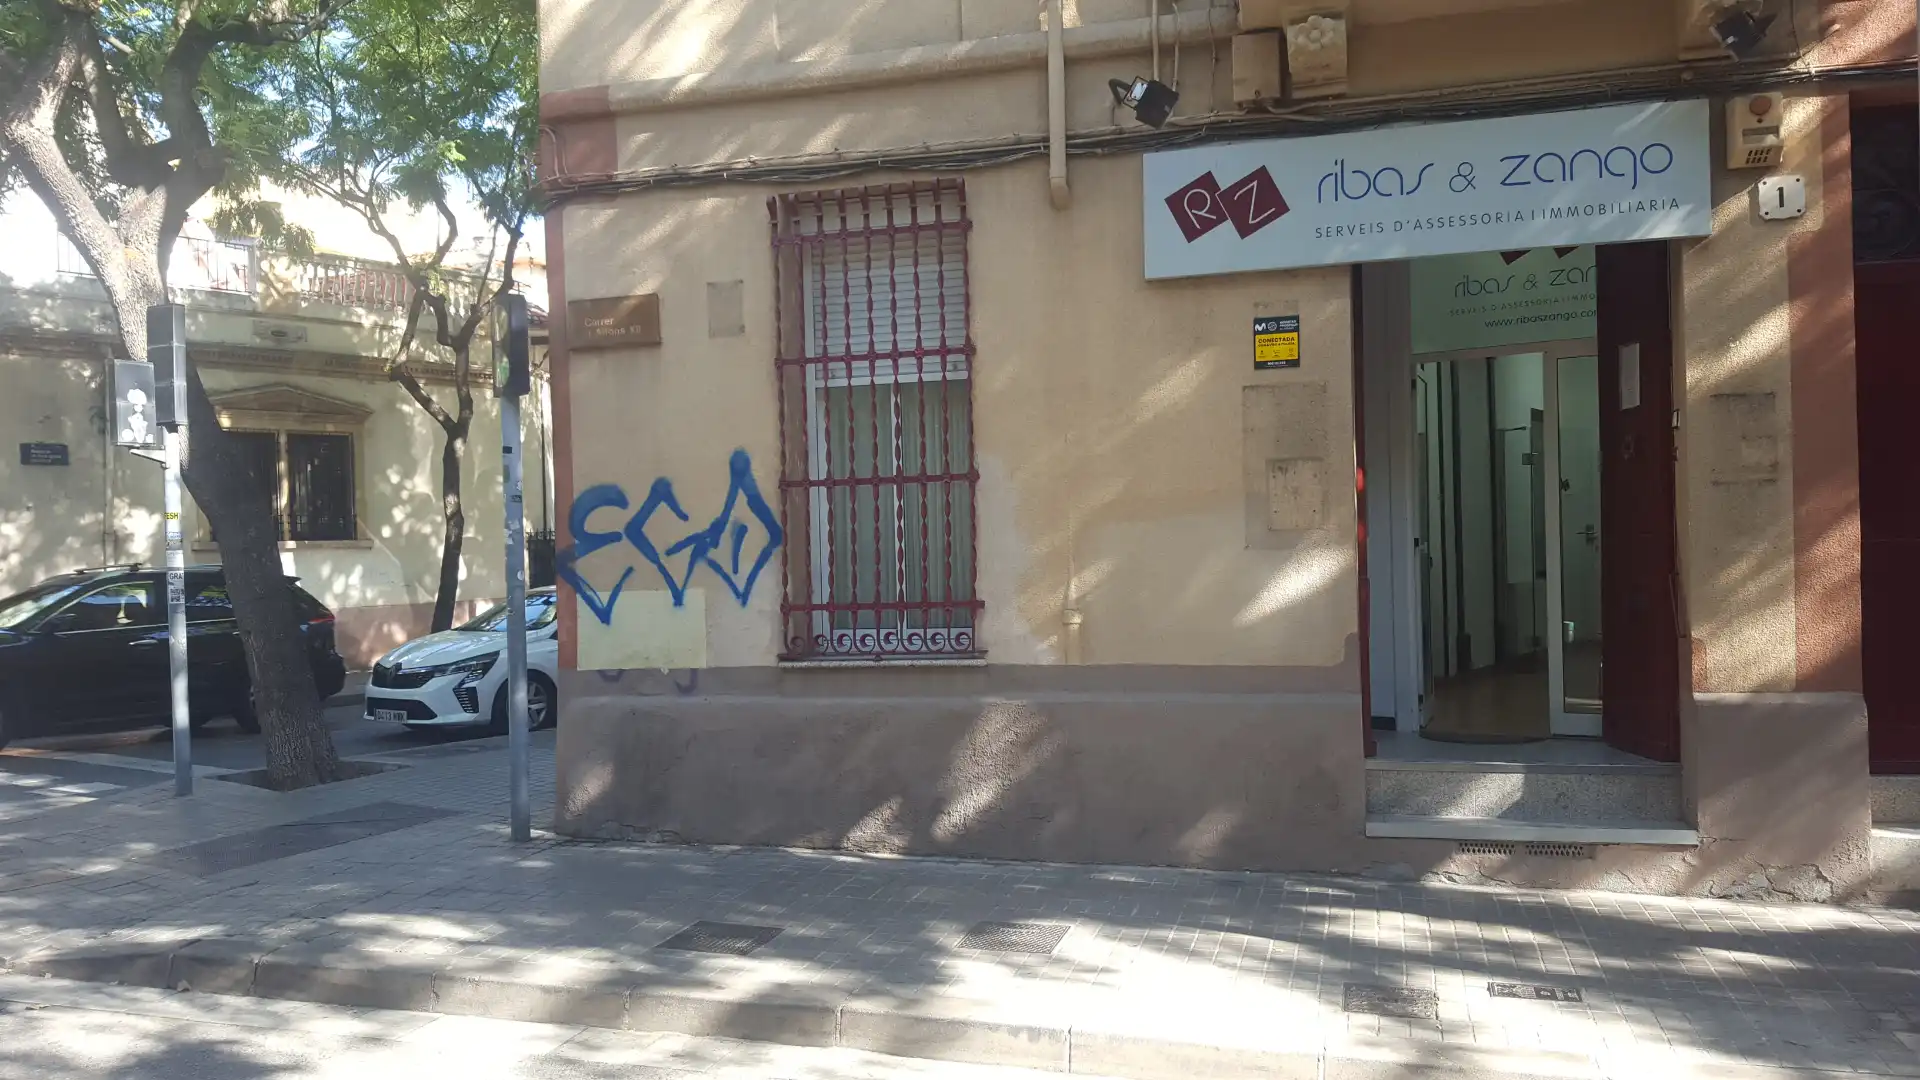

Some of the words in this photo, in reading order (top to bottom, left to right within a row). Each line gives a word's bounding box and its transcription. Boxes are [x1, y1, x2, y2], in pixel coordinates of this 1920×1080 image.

[1317, 158, 1435, 204] ribas
[1448, 161, 1477, 193] &
[1499, 142, 1674, 190] zango
[1775, 186, 1785, 208] 1
[1315, 221, 1385, 239] SERVEIS
[1394, 210, 1525, 233] D'ASSESSORIA
[1541, 197, 1681, 219] IMMOBILIARIA
[1454, 274, 1516, 298] ribas
[1522, 273, 1539, 291] &
[1450, 306, 1487, 317] SERVEIS
[1491, 297, 1559, 312] DASSESSORIA
